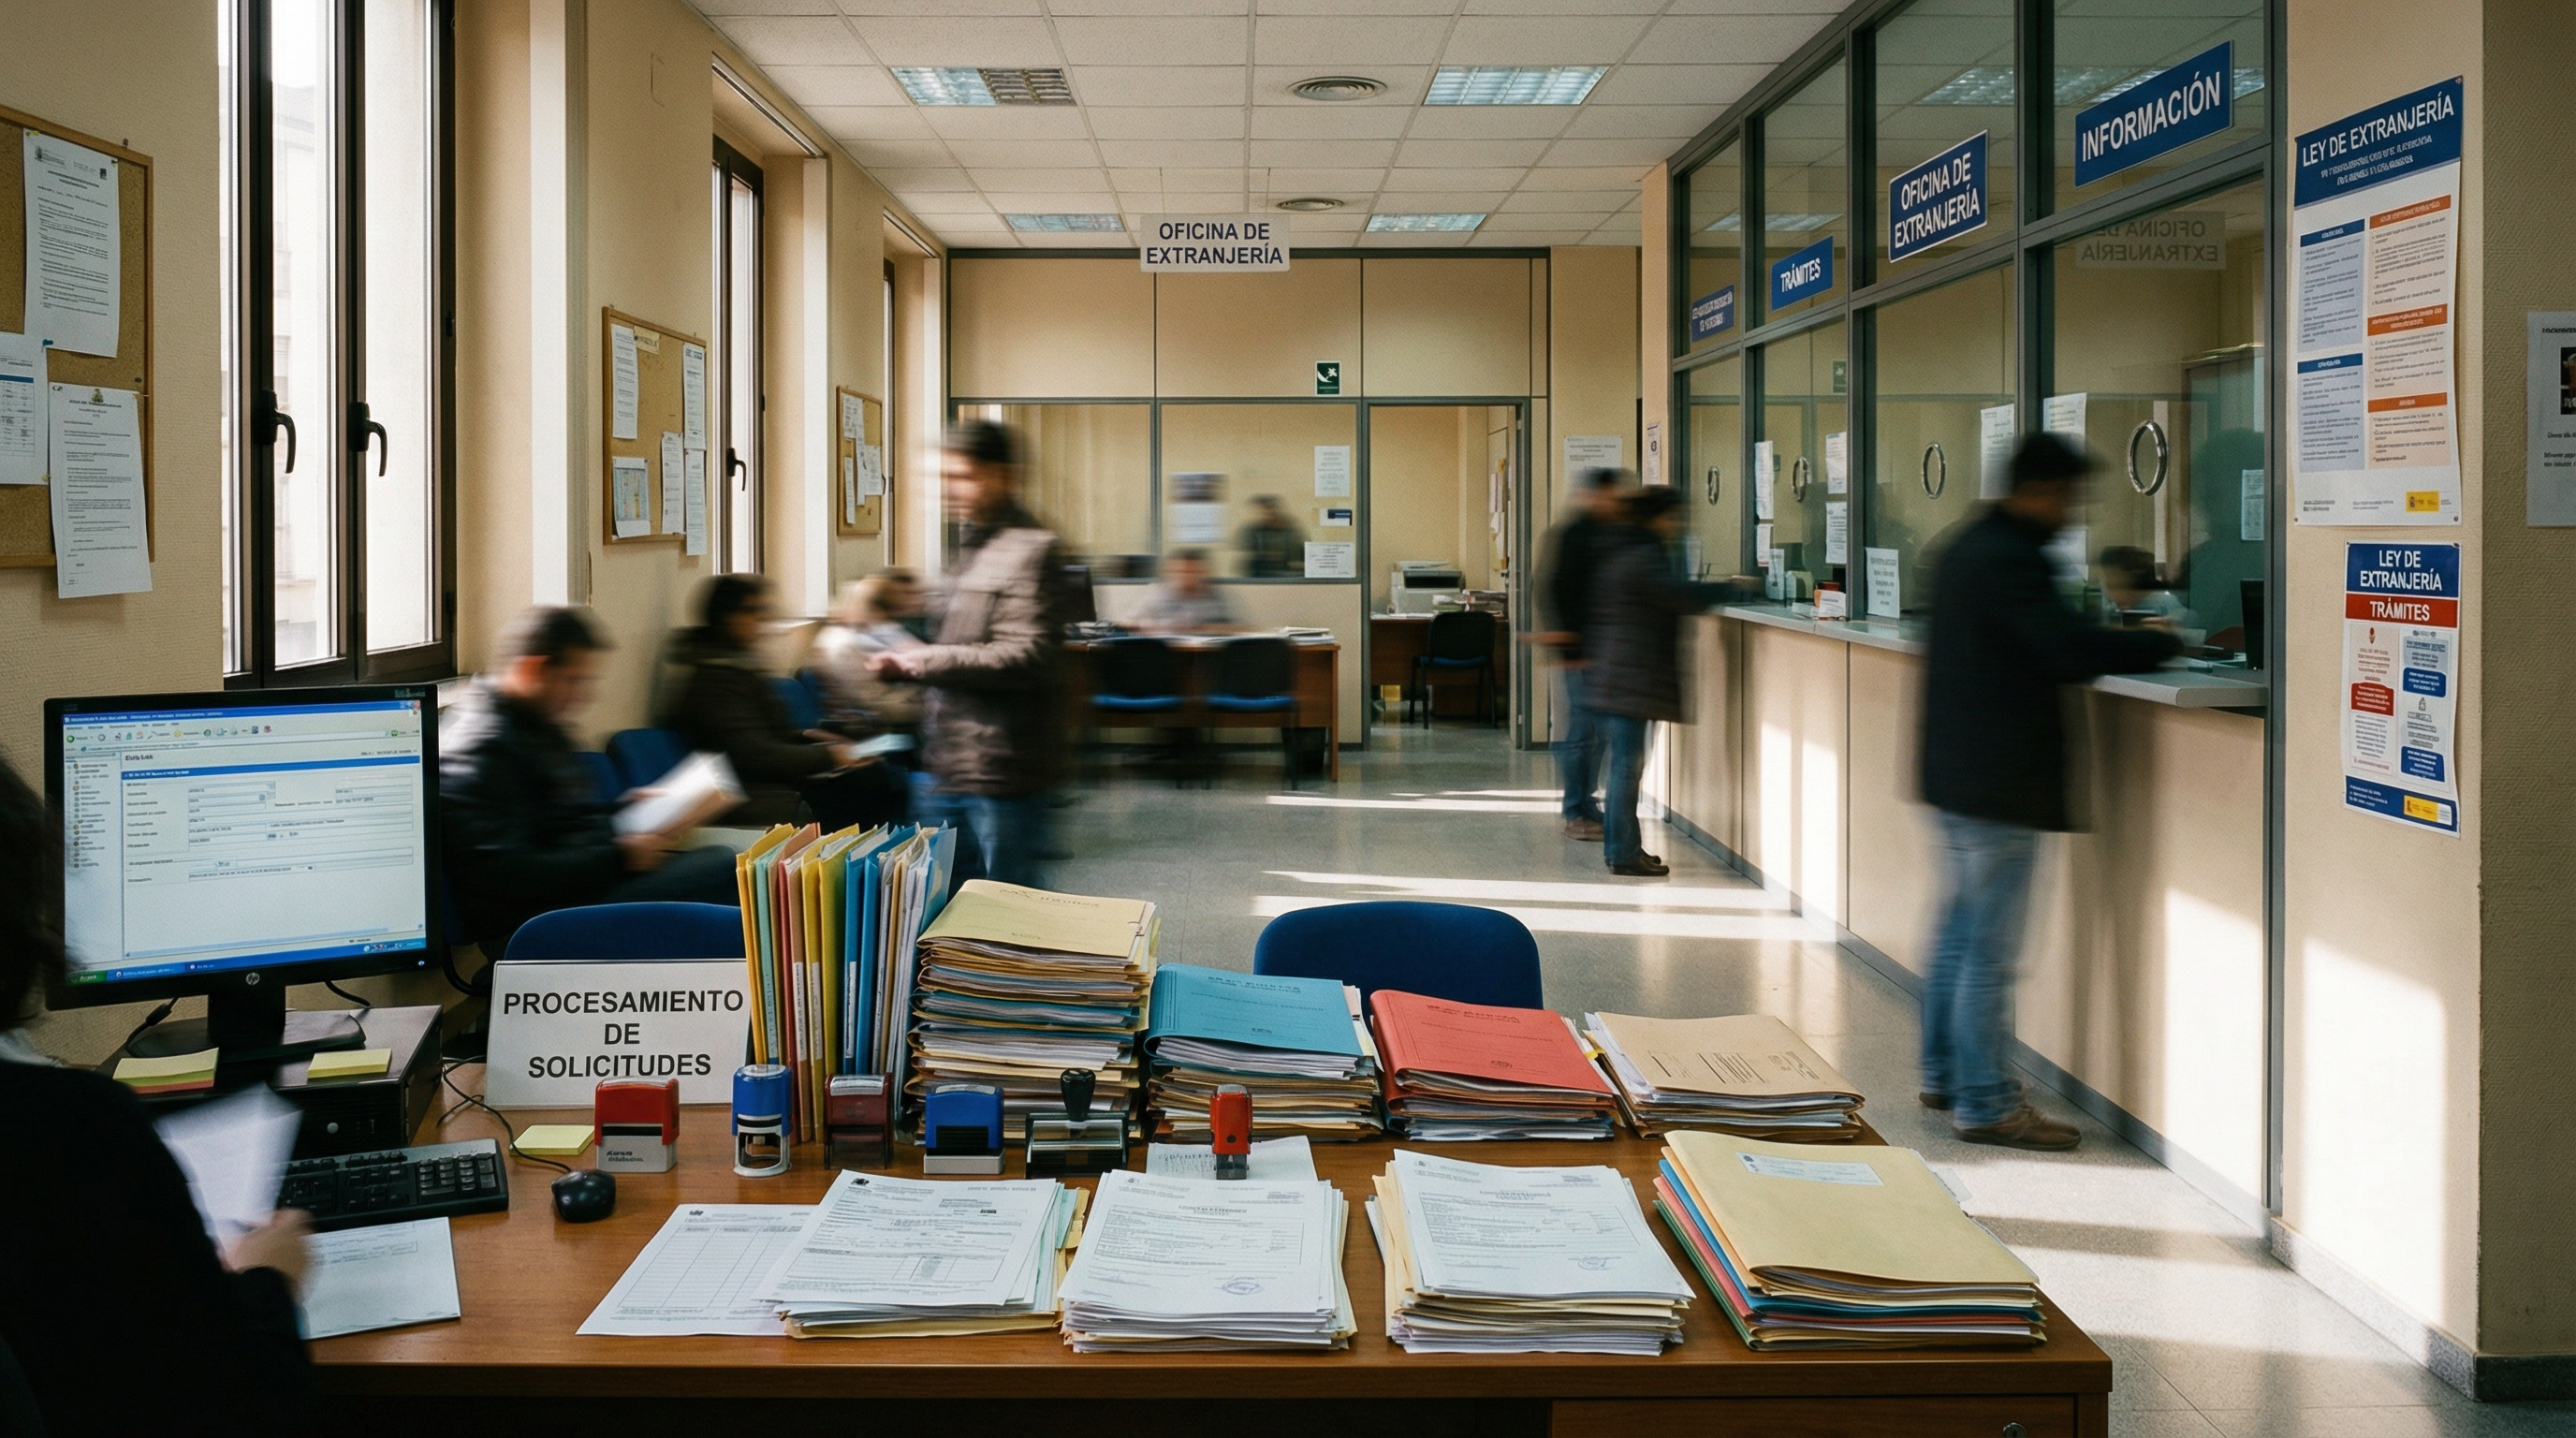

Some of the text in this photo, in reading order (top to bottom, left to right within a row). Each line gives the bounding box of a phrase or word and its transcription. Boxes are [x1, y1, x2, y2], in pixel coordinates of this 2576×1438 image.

[2083, 71, 2220, 162] INFORMACIÓN
[2303, 139, 2326, 167] LEY
[2329, 132, 2347, 157] DE
[2350, 91, 2454, 150] EXTRANJERÍA
[1901, 152, 1971, 211] OFICINA DE
[1895, 183, 1981, 249] EXTRANJERÍA
[1159, 223, 1270, 240] OFICINA DE
[1147, 242, 1283, 264] EXTRANJERÍA
[2378, 550, 2422, 568] LEY DE
[2360, 568, 2442, 591] EXTRANJERÍA
[2369, 597, 2430, 622] TRÁMITES
[504, 990, 743, 1014] PROCESAMIENTO
[604, 1023, 640, 1045] DE
[528, 1053, 711, 1078] SOLICITUDES
